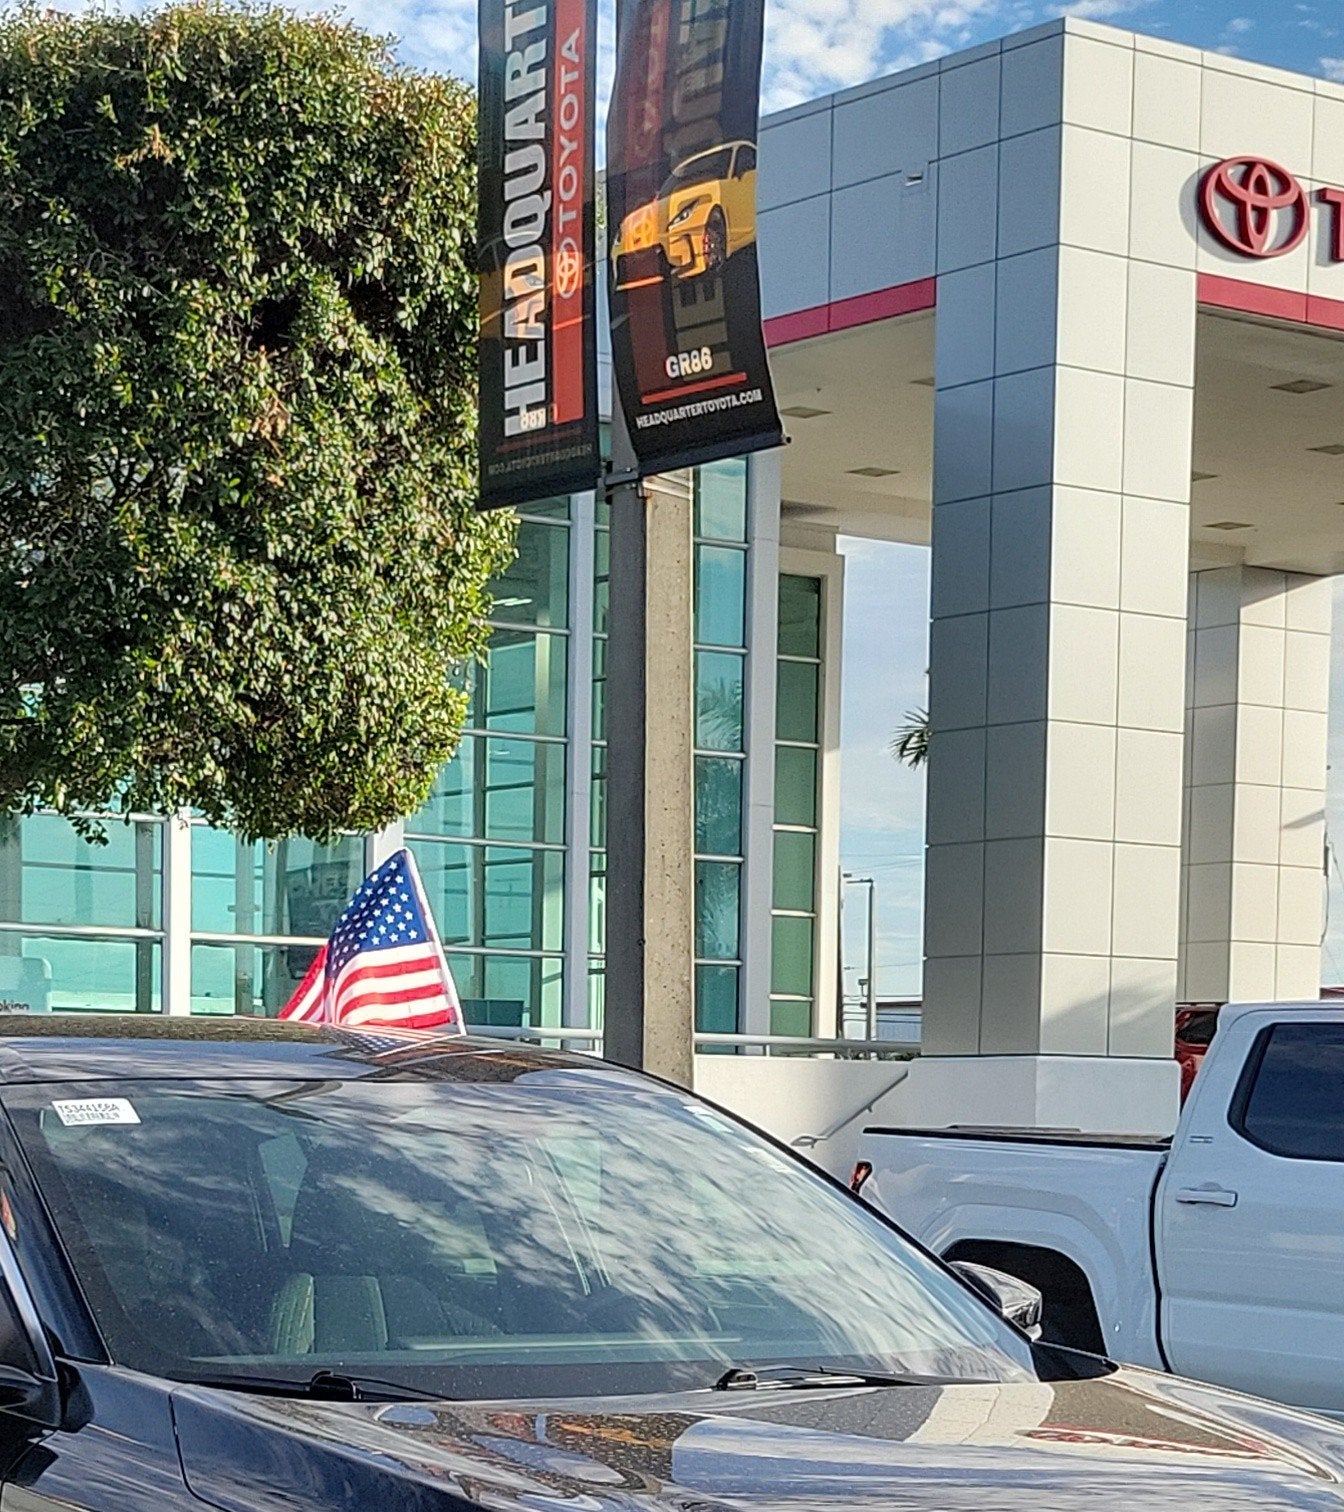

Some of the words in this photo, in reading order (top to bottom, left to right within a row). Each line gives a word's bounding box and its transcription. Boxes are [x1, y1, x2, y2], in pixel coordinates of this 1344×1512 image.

[558, 27, 581, 230] TOYOTA
[503, 0, 552, 437] HEADQUART
[635, 388, 763, 430] HEADQUARTERTOYOTA.COM
[665, 347, 714, 379] GR86
